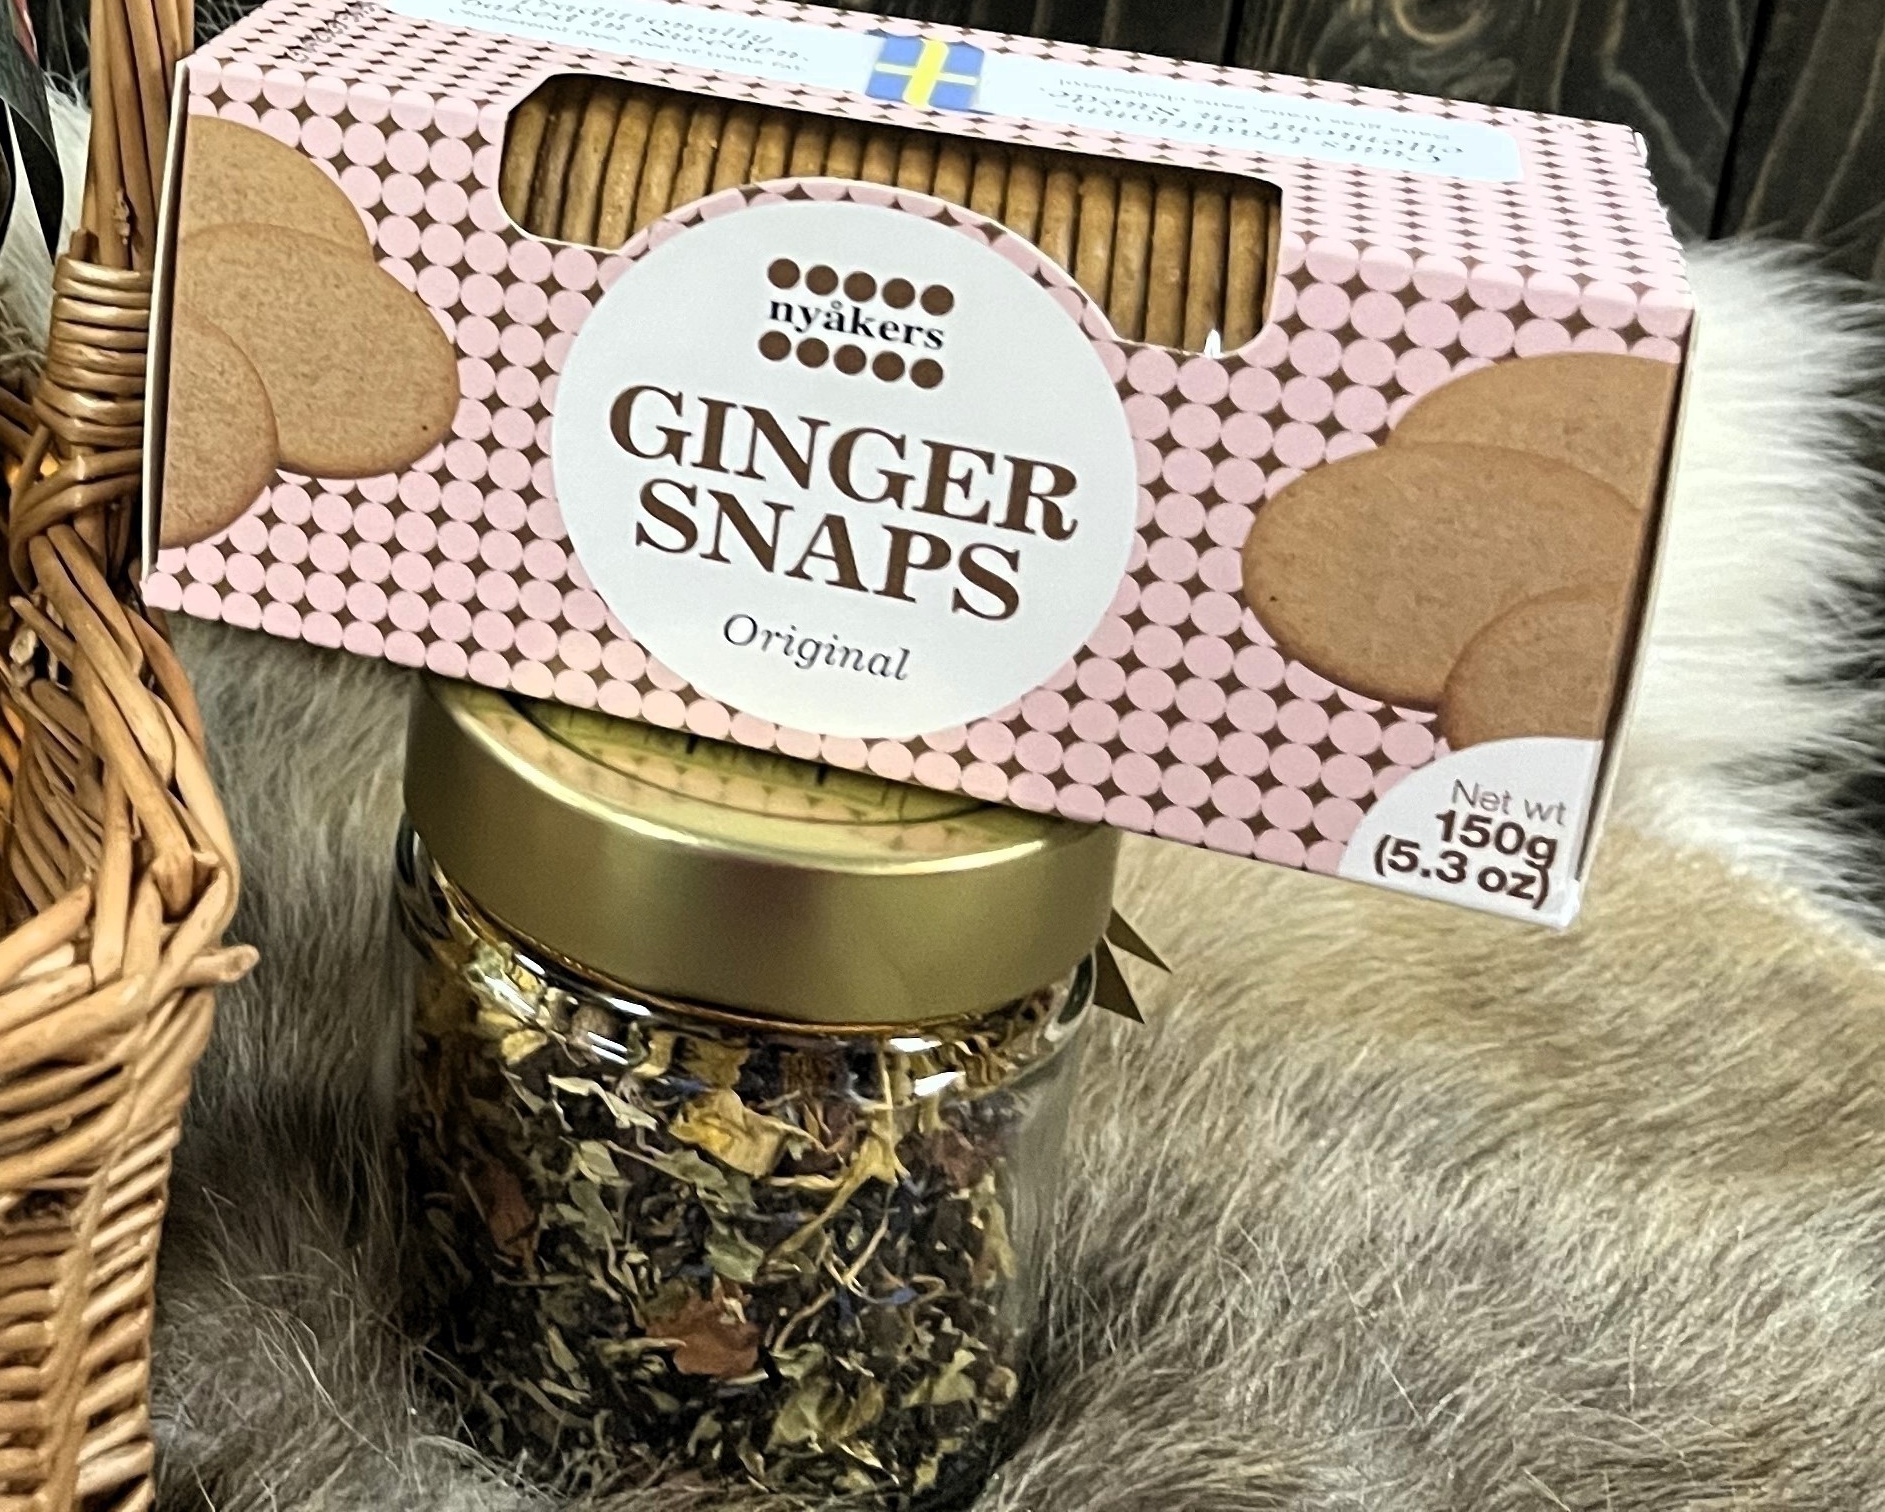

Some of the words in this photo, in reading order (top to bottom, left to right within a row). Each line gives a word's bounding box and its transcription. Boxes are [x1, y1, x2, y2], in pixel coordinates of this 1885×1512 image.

[768, 298, 946, 351] nyåkers
[609, 384, 1079, 542] GINGER
[635, 477, 1021, 622] SNAPS
[723, 612, 911, 682] Original
[1451, 778, 1512, 815] Net
[1524, 798, 1567, 826] wt
[1374, 833, 1469, 884] (5.3
[1477, 864, 1550, 910] oz)
[1435, 808, 1559, 870] 150g
